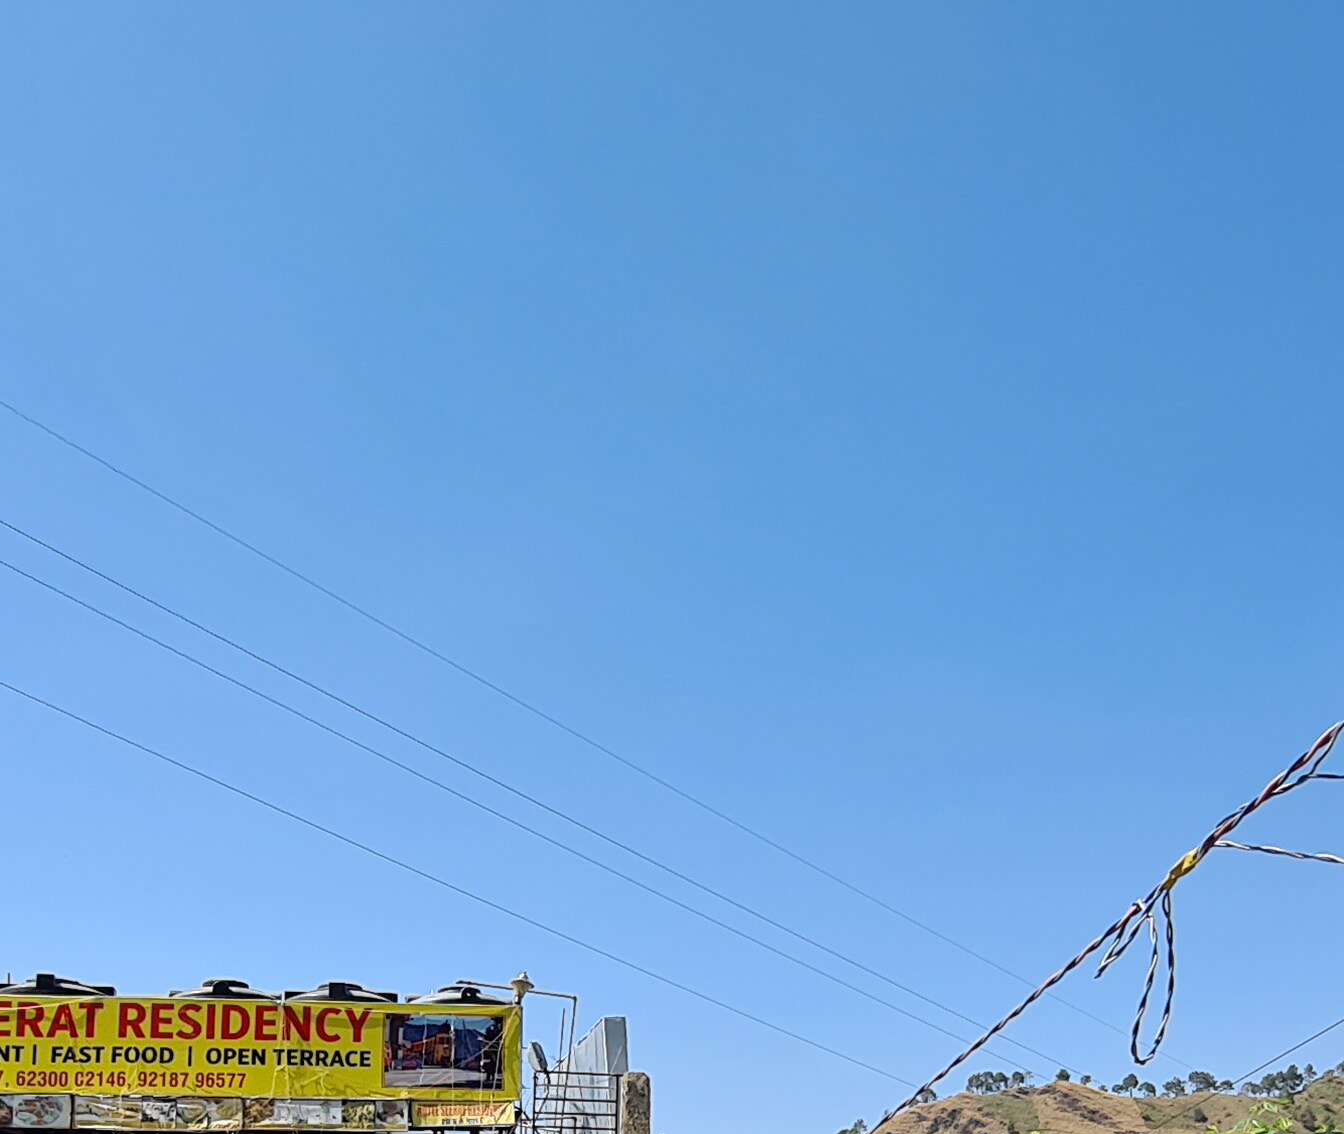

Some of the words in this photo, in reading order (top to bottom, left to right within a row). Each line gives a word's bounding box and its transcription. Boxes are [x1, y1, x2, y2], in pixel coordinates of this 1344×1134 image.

[118, 1003, 372, 1043] RESIDENCY
[51, 1046, 105, 1064] FAST
[111, 1046, 174, 1064] FOOD
[206, 1048, 266, 1066] OPEN
[273, 1049, 371, 1067] TERRACE
[16, 1071, 68, 1087] 62300
[138, 1072, 189, 1088] 92187
[195, 1072, 247, 1089] 96577
